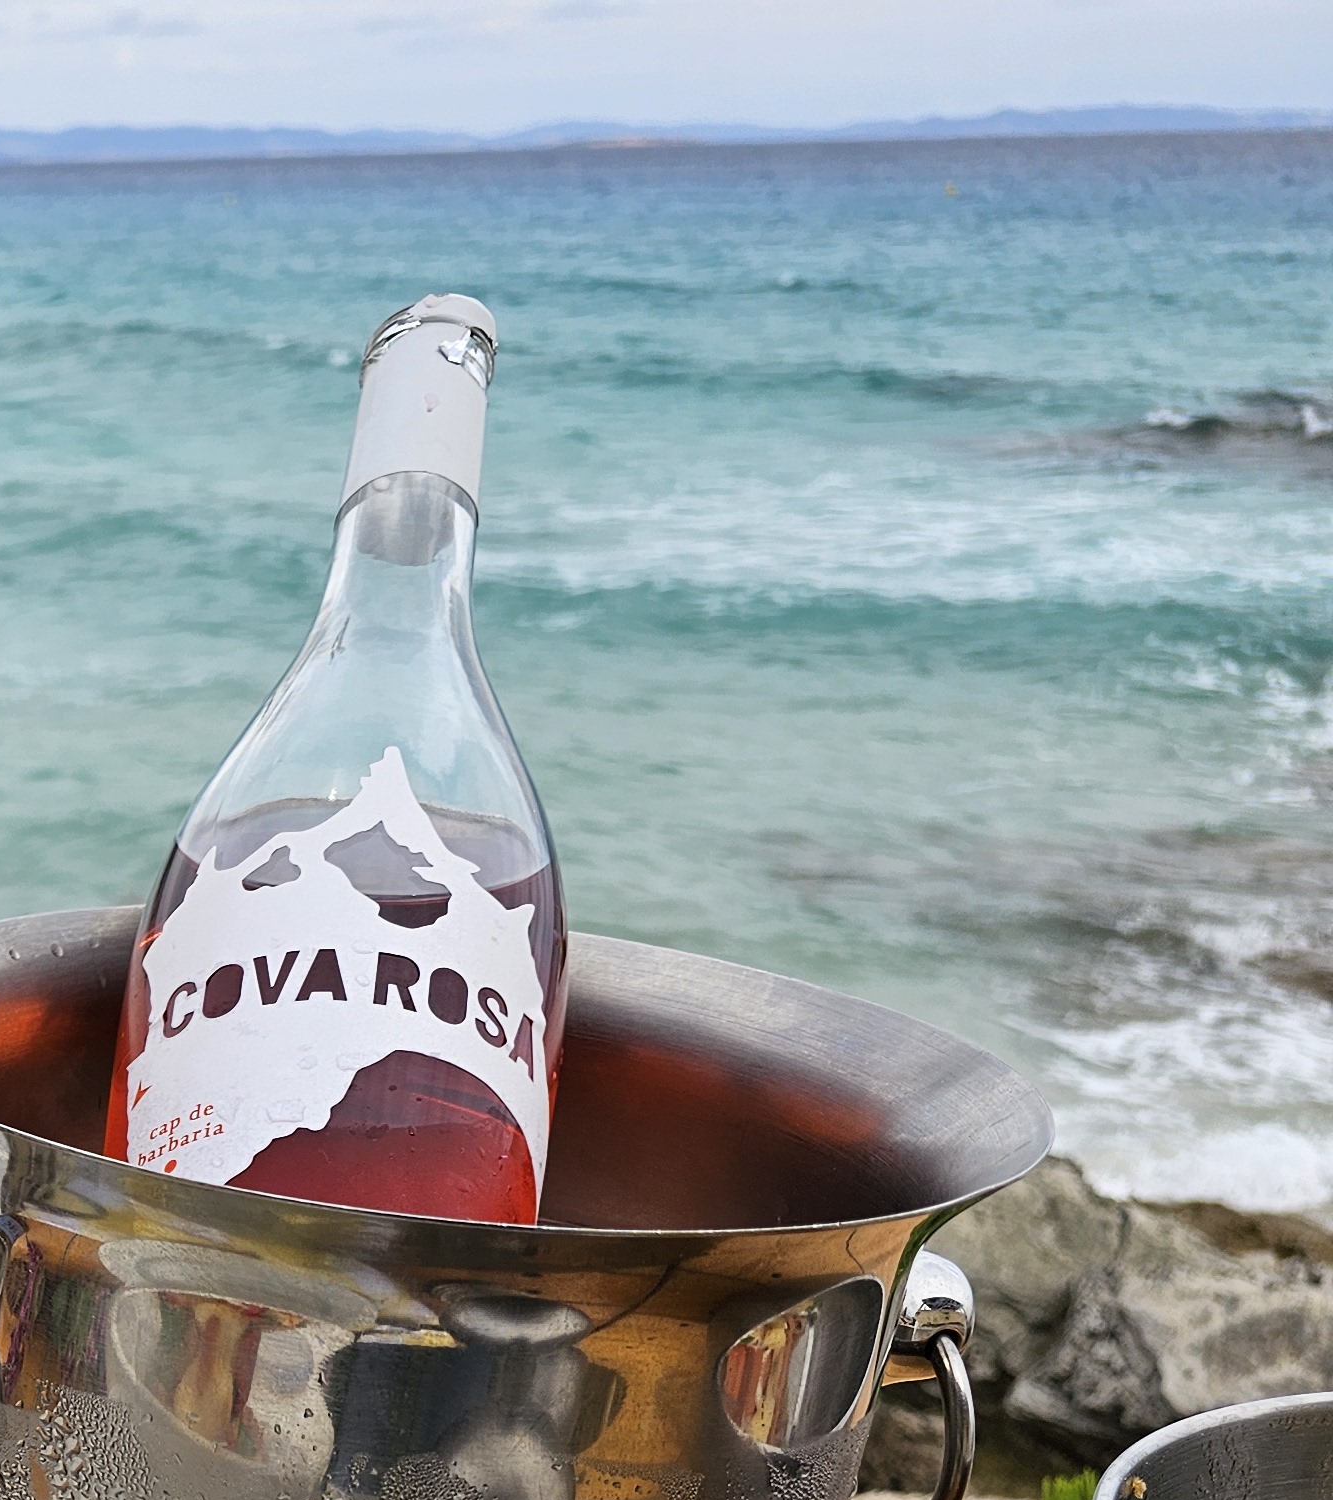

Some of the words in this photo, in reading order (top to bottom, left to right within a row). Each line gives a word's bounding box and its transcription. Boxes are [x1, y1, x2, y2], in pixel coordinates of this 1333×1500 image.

[162, 948, 347, 1039] COVA
[373, 951, 535, 1083] ROSA
[149, 1117, 181, 1140] cap
[189, 1103, 214, 1121] de
[137, 1122, 225, 1167] barbaria
